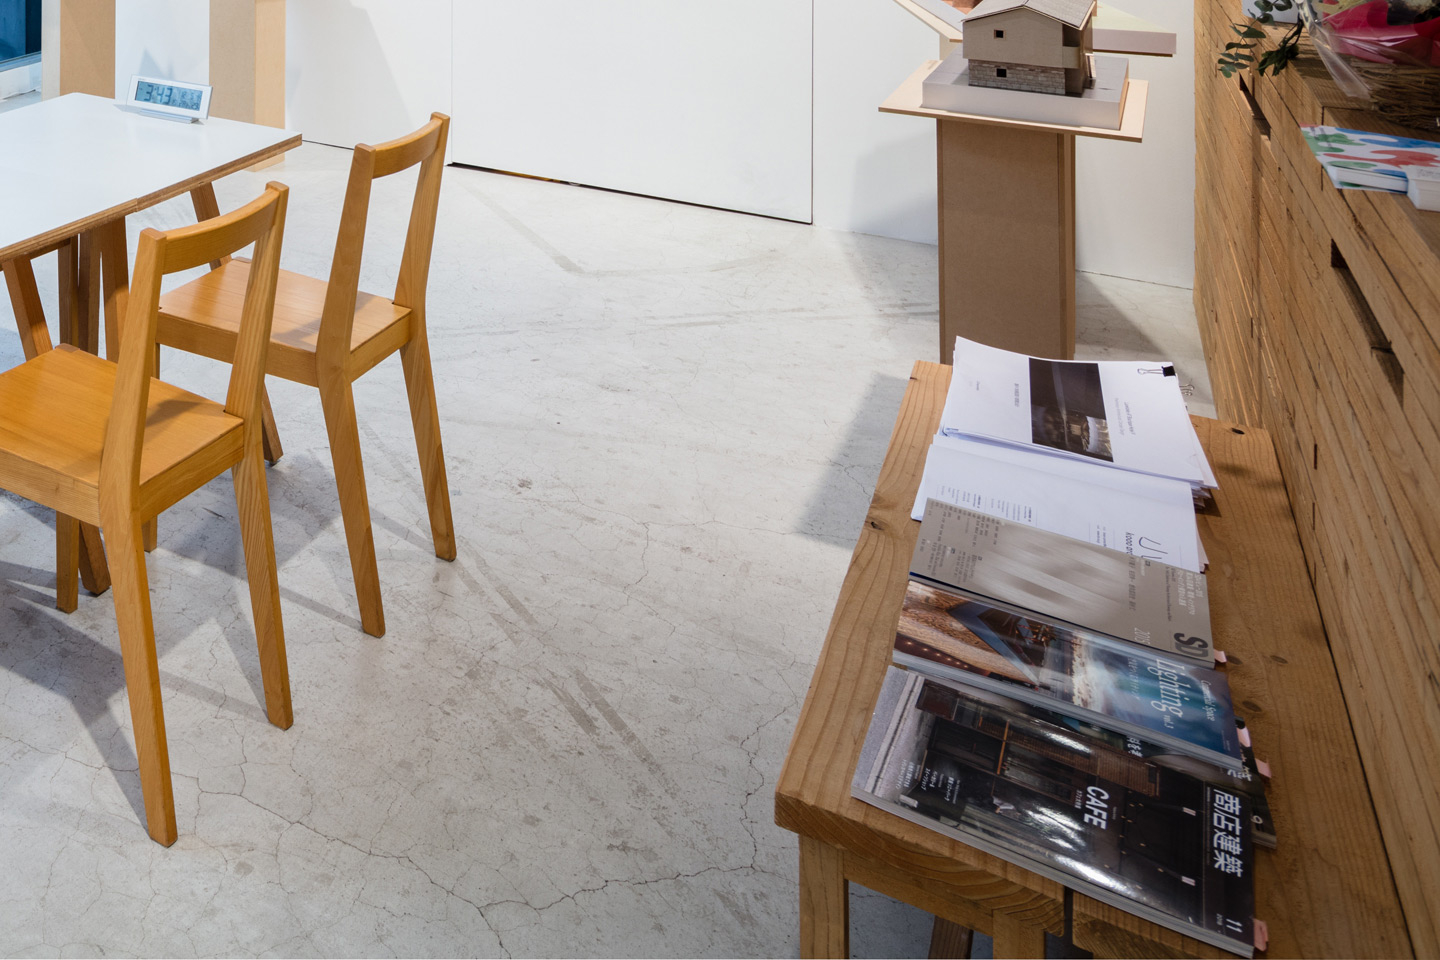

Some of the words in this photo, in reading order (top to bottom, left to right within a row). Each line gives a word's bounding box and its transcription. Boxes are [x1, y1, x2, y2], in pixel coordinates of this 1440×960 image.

[144, 83, 173, 105] 3:43
[1173, 632, 1209, 657] SD
[1147, 658, 1192, 718] Lighting
[1163, 715, 1174, 729] vol.3
[1202, 705, 1216, 721] Space
[1083, 785, 1110, 830] CAFE
[1213, 789, 1244, 878] 商店建築
[1225, 917, 1243, 933] 11
